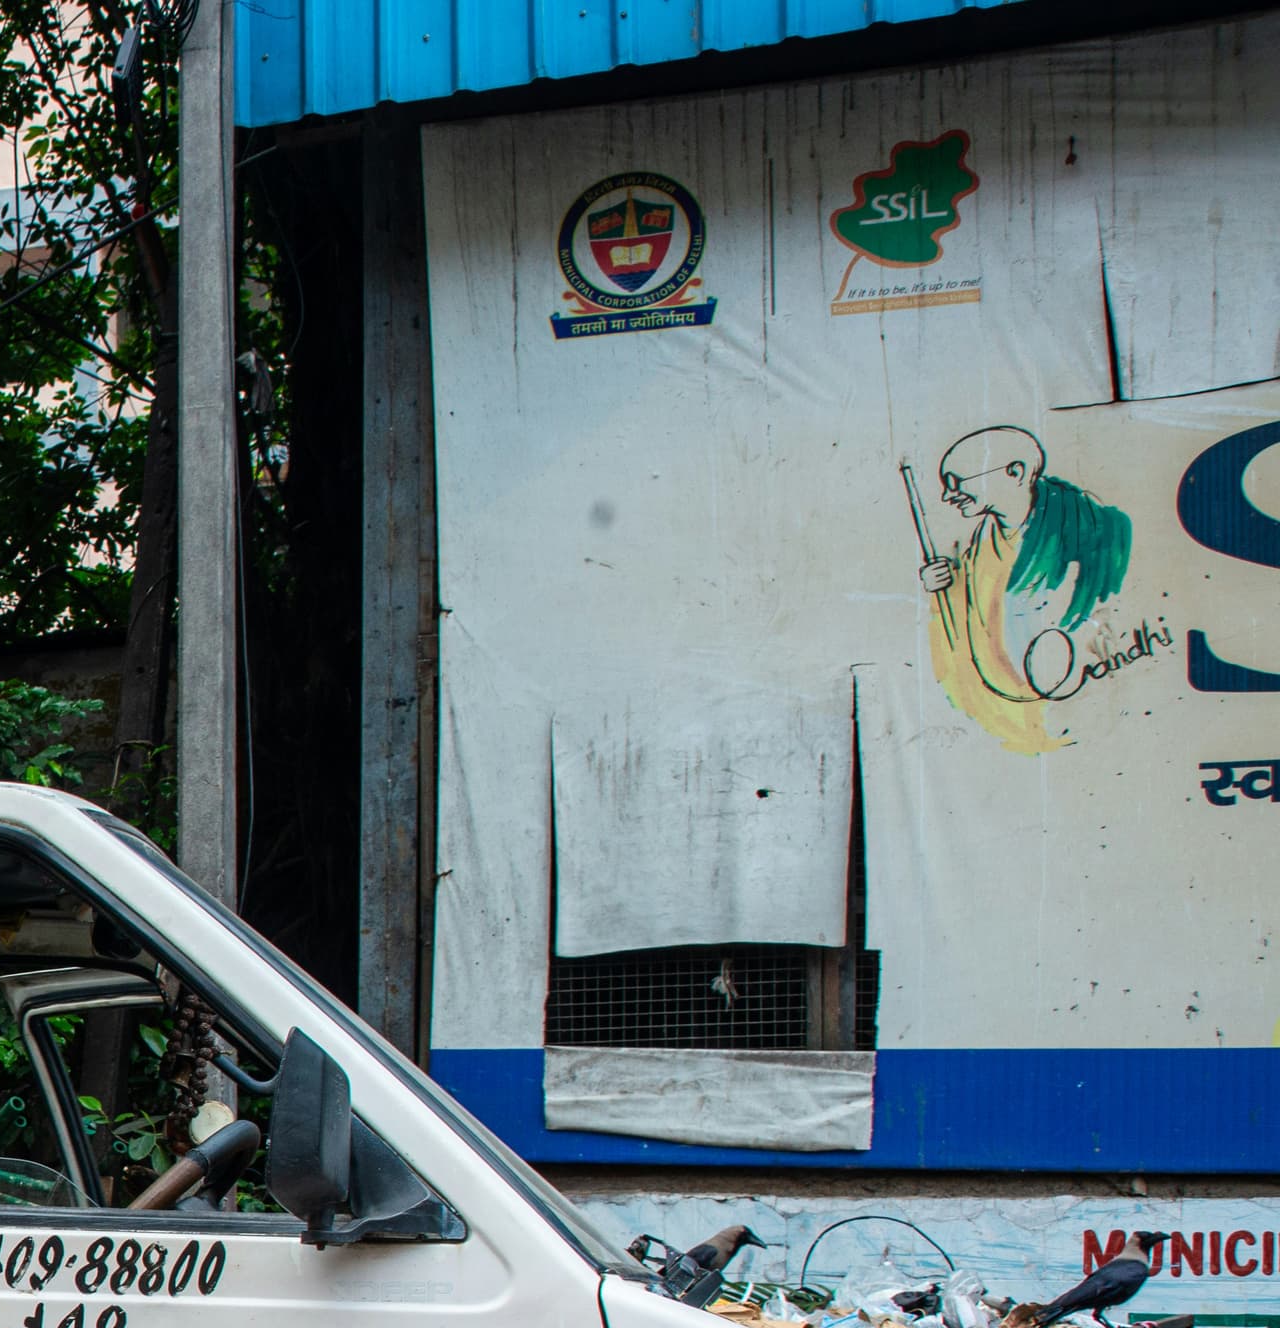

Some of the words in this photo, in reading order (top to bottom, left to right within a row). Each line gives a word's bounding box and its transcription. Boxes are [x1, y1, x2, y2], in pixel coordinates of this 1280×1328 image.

[560, 249, 594, 299] MUNICIPAL
[597, 283, 676, 308] CORPORATION
[677, 268, 690, 282] OF
[686, 233, 703, 264] DELHI
[929, 281, 942, 292] up
[945, 279, 958, 289] to
[571, 316, 607, 335] तमसो
[611, 318, 626, 331] मा
